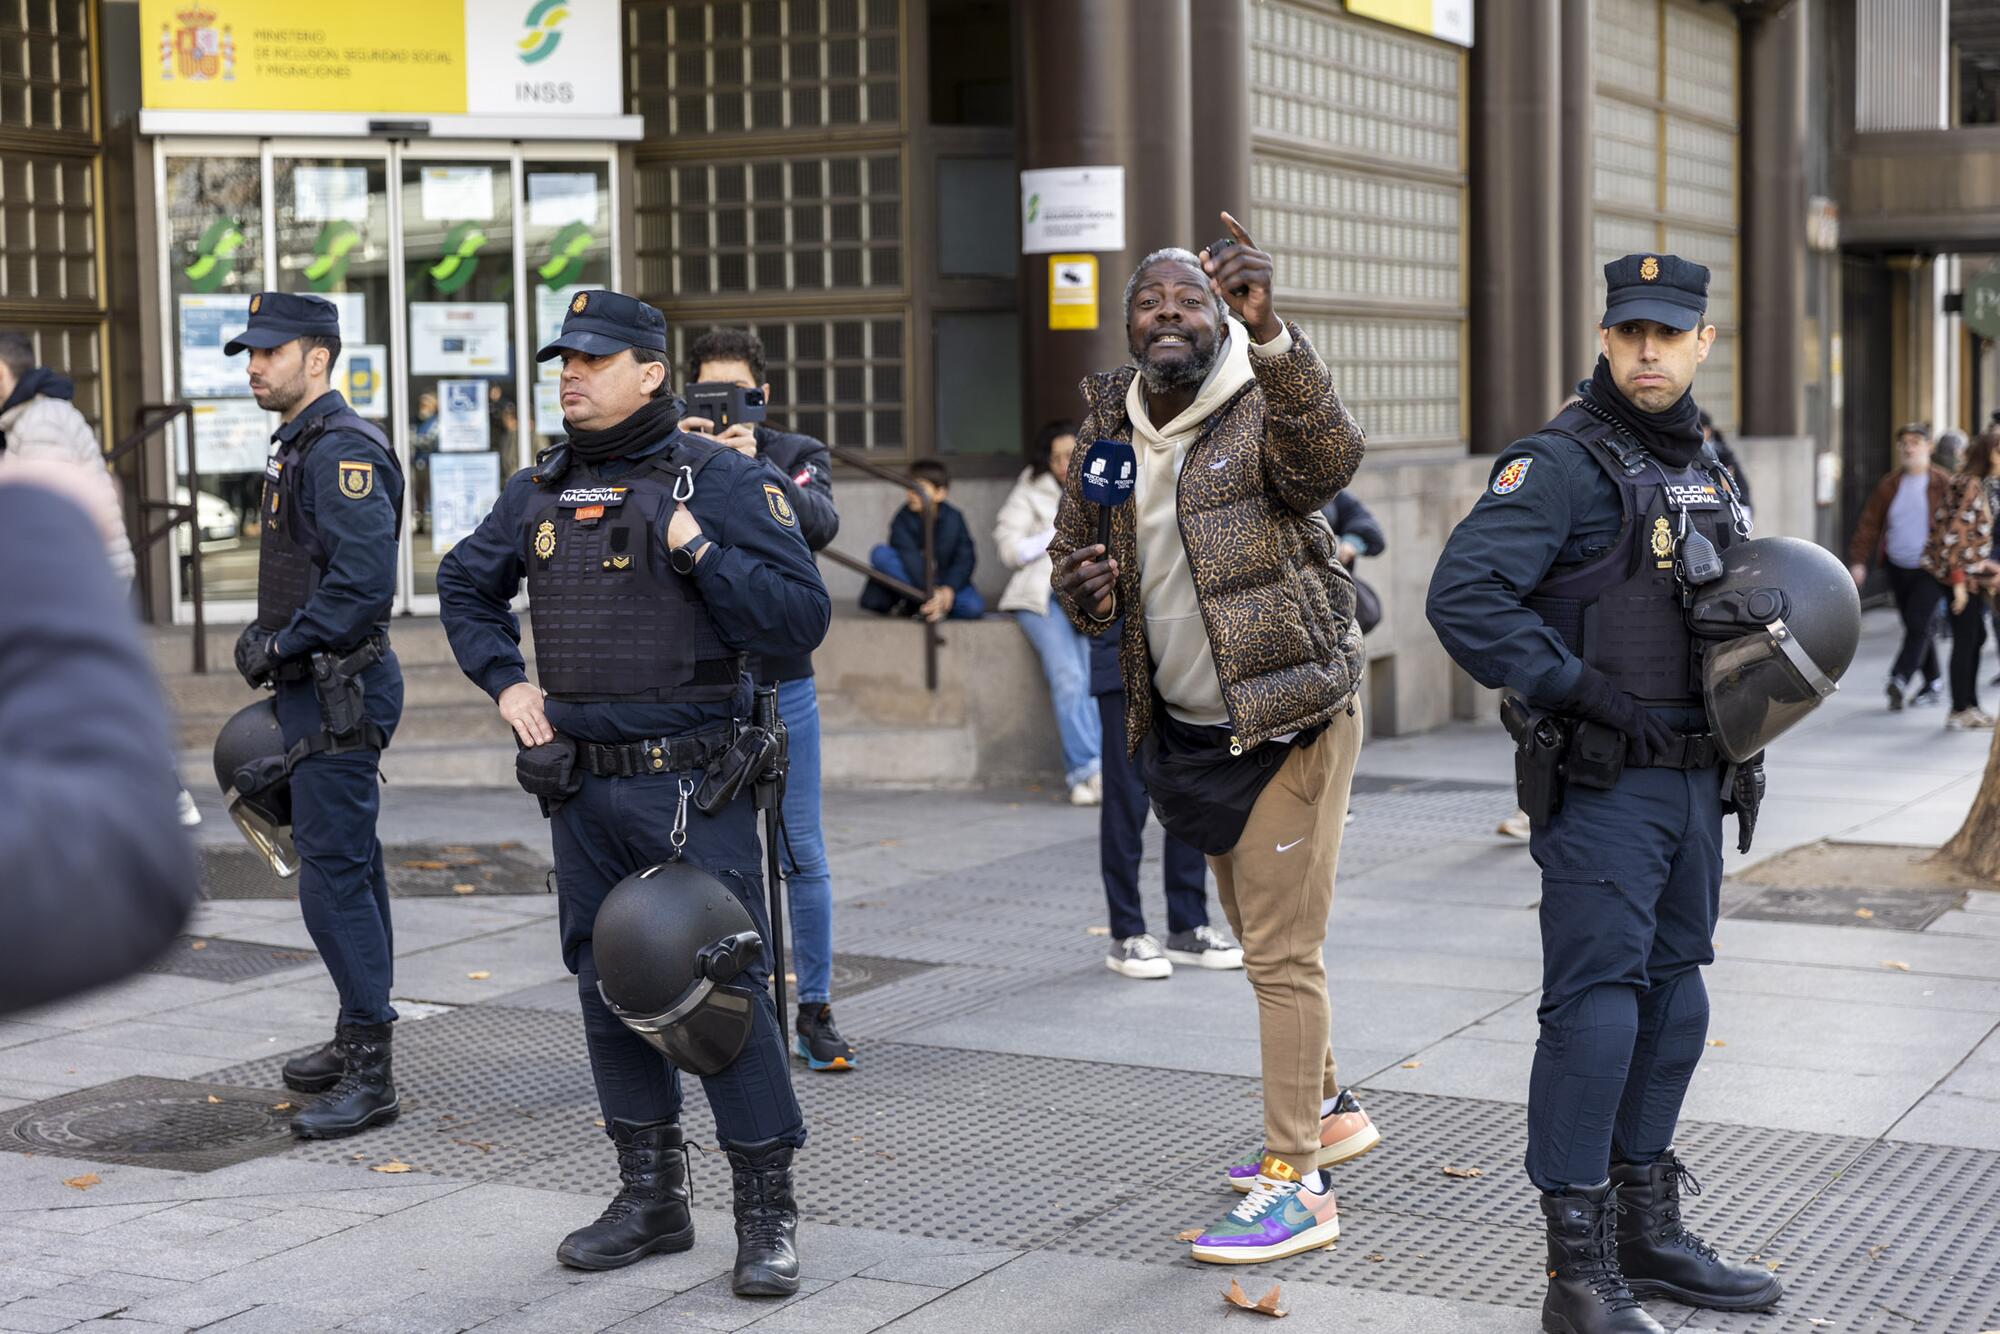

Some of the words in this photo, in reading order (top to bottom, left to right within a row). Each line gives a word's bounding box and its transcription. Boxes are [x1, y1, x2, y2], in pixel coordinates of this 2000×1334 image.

[515, 81, 575, 104] INSS
[560, 493, 622, 501] NACIONAL
[1668, 495, 1719, 504] NACIONAL
